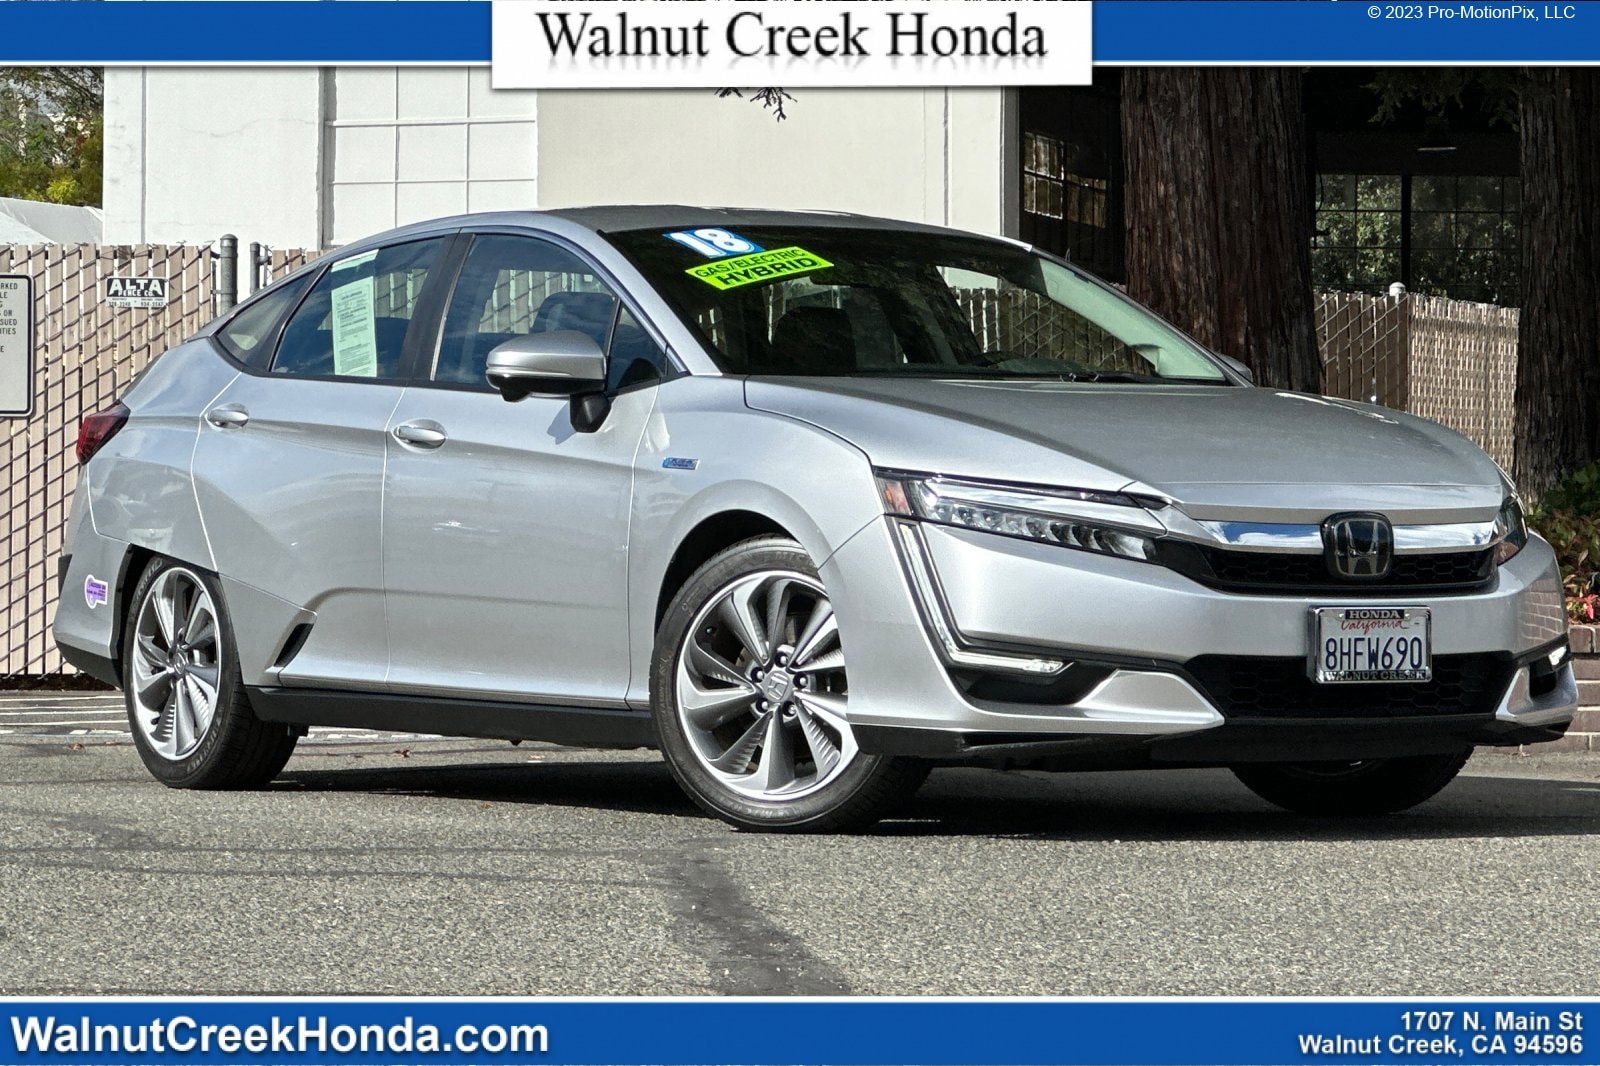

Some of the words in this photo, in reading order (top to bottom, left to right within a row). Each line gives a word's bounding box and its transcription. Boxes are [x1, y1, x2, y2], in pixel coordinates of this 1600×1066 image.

[669, 228, 752, 258] 18
[695, 249, 808, 278] GAS/ELECTRIC
[715, 257, 819, 285] HYBRID
[0, 282, 18, 290] RKED
[108, 279, 163, 296] ALTA
[1349, 610, 1401, 619] HONDA
[1341, 619, 1410, 635] California
[1325, 636, 1423, 670] 8HFW690
[1325, 671, 1378, 681] WALNUT
[1380, 670, 1425, 680] CREEK
